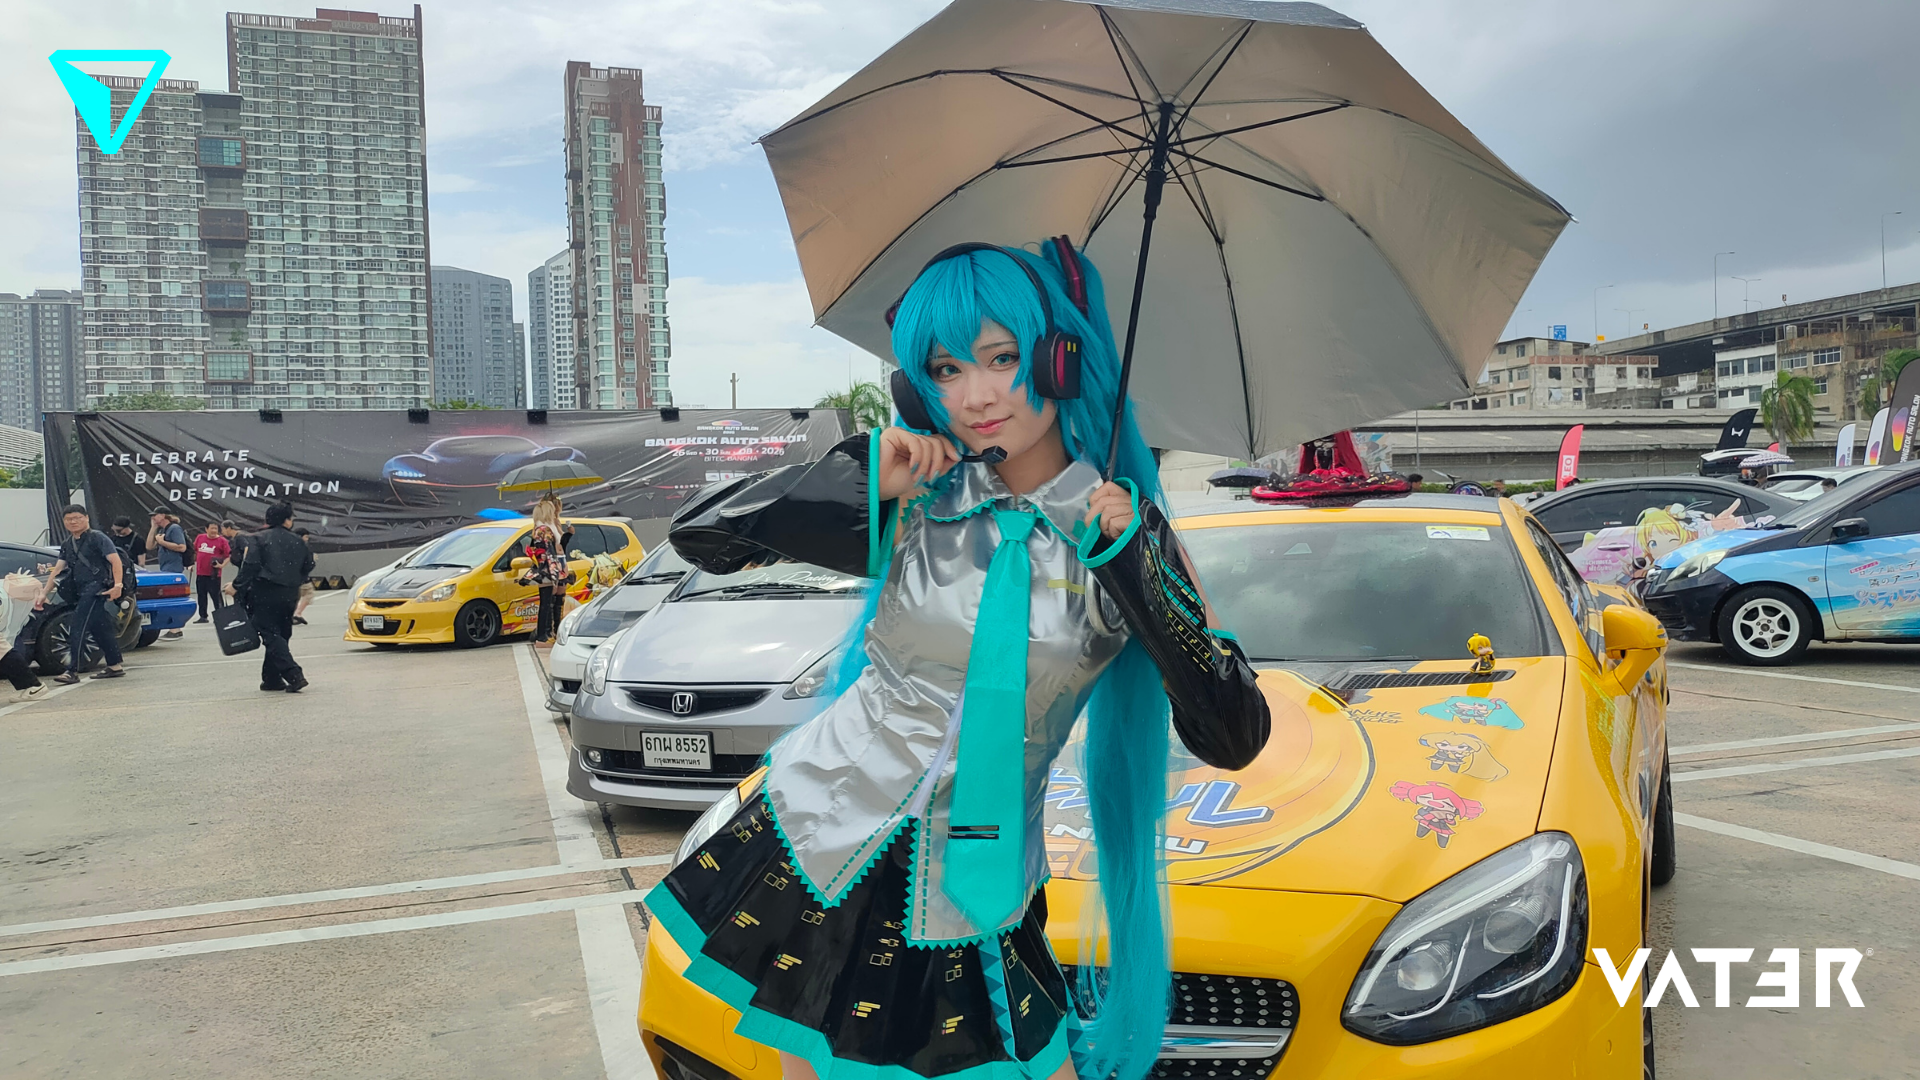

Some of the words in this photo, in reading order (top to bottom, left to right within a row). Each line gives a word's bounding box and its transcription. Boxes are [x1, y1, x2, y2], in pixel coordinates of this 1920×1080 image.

[645, 437, 718, 447] BANGKOK
[720, 436, 759, 445] AUTO
[761, 434, 807, 444] SALON
[102, 450, 249, 467] CELEBRATE
[705, 448, 719, 456] 30
[761, 446, 785, 456] 2026
[134, 467, 255, 484] BANGKOK
[169, 481, 340, 502] DESTINATION
[778, 571, 838, 586] Racing
[675, 738, 707, 753] 8552
